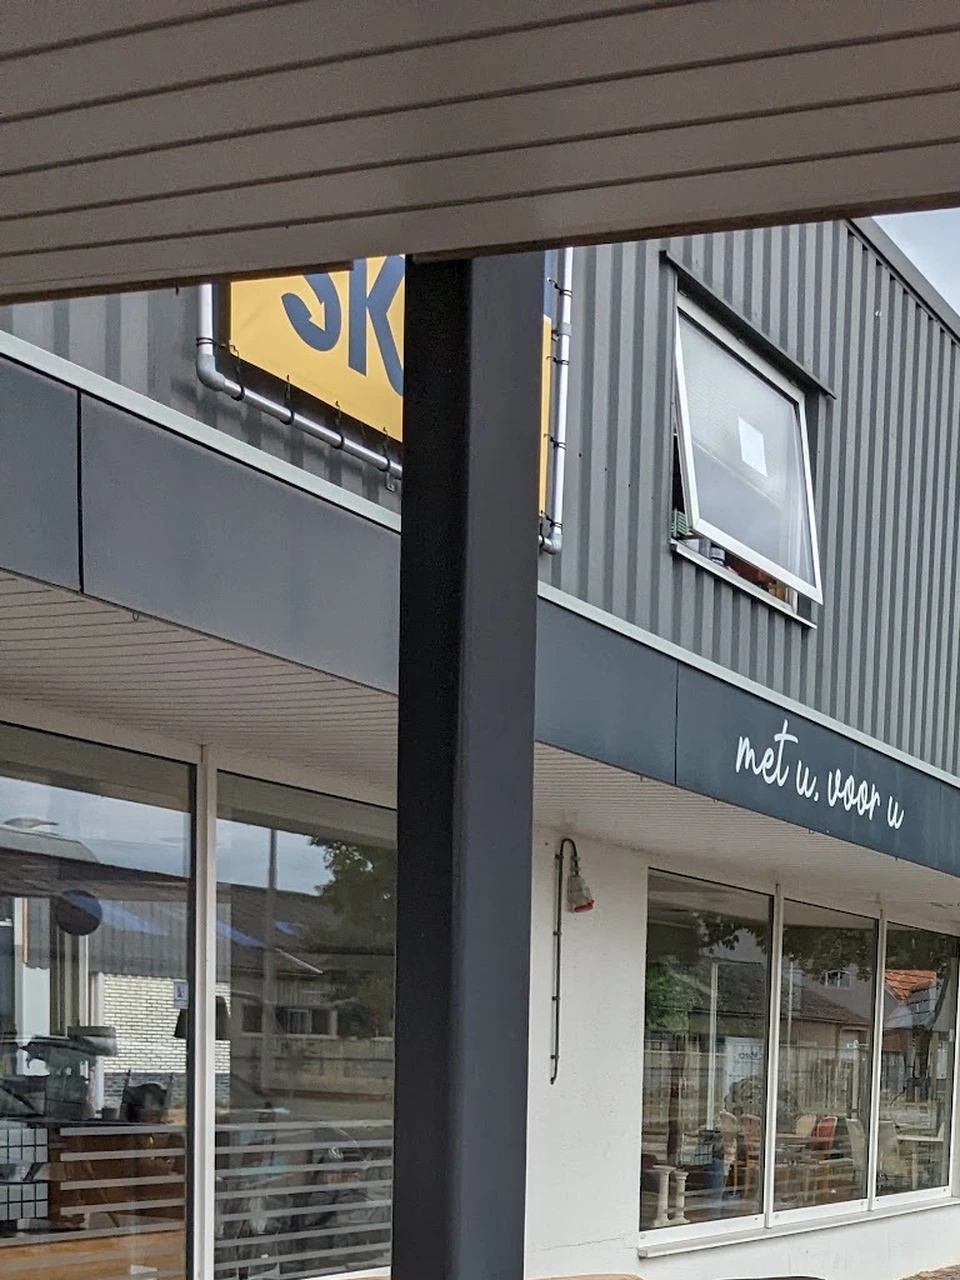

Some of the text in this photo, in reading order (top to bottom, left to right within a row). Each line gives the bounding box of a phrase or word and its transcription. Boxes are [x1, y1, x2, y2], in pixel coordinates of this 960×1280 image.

[736, 719, 799, 787] met
[828, 768, 881, 820] voor
[887, 795, 904, 829] u
